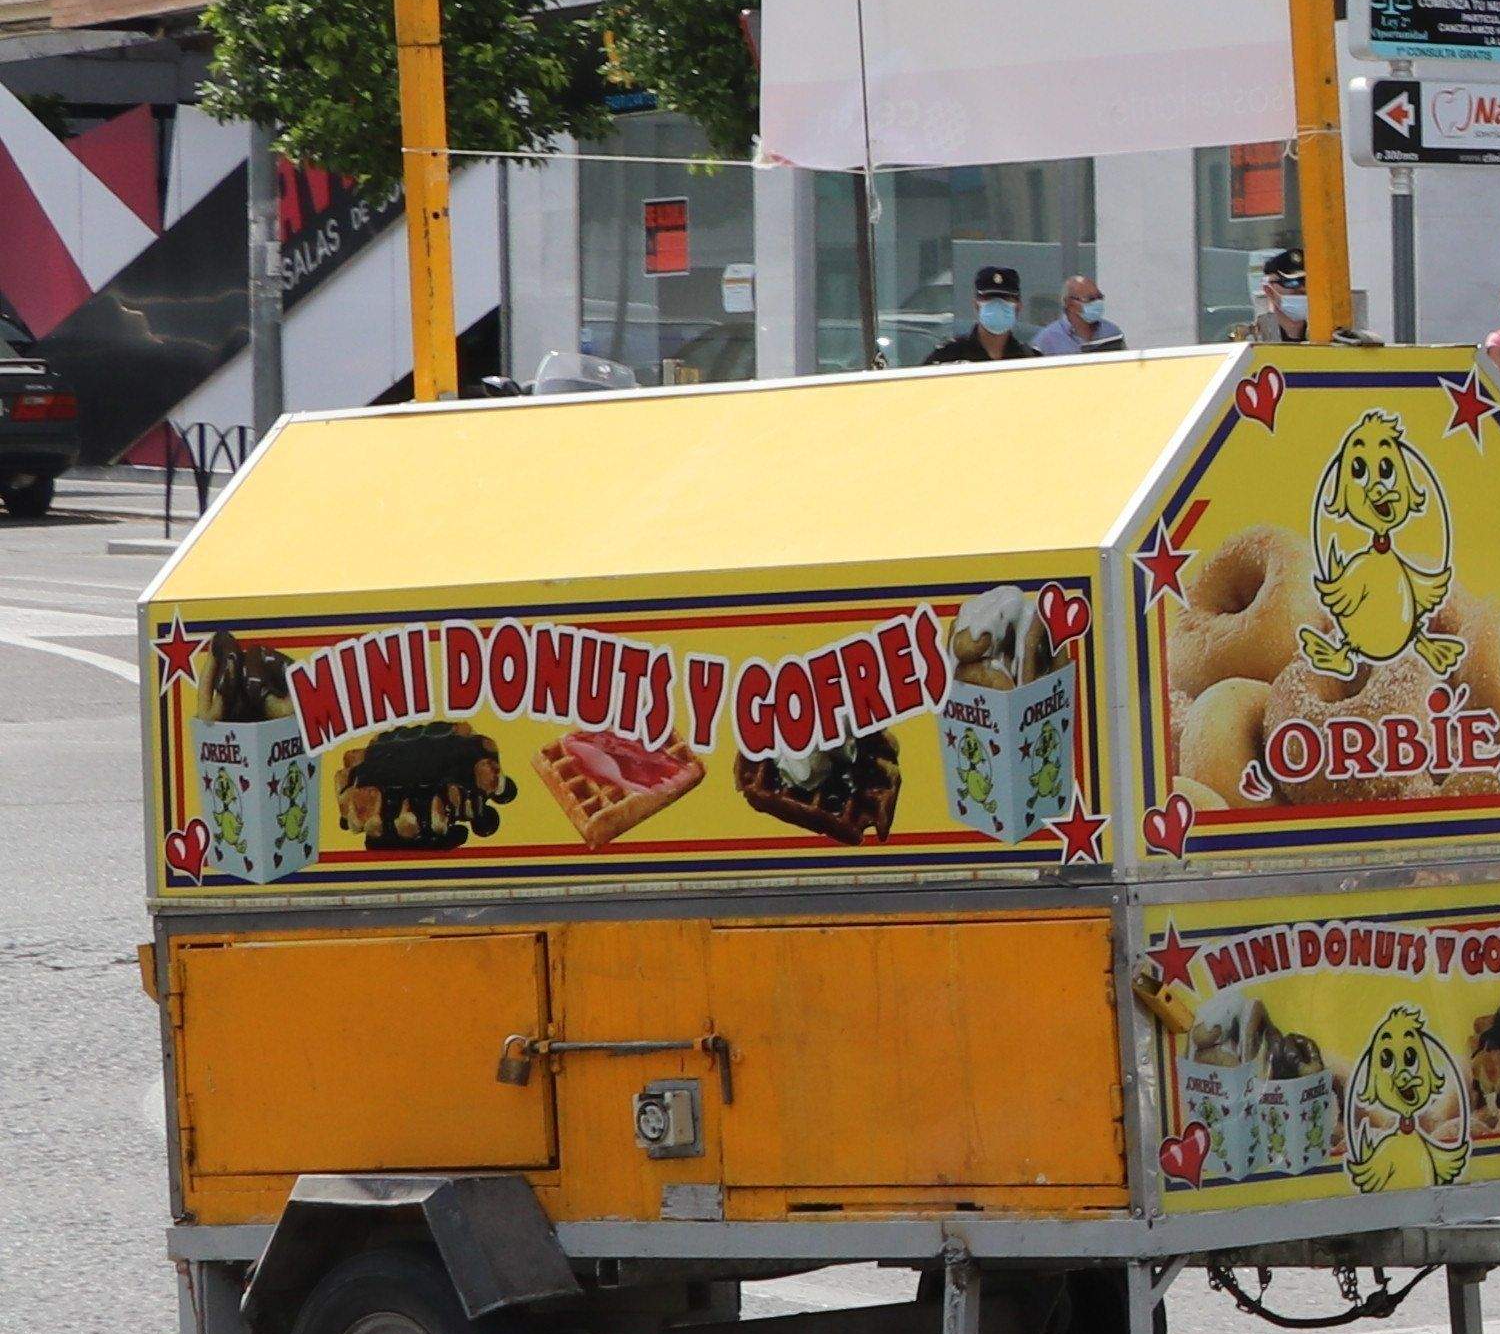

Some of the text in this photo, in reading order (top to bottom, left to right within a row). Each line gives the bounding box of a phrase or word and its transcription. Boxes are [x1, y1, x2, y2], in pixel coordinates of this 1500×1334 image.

[281, 217, 341, 291] SALAS
[290, 612, 948, 754] MINI DONUTS Y GOFRES
[1205, 931, 1292, 990] MINI
[1299, 926, 1427, 976] DONUTS
[1435, 935, 1456, 975] Y
